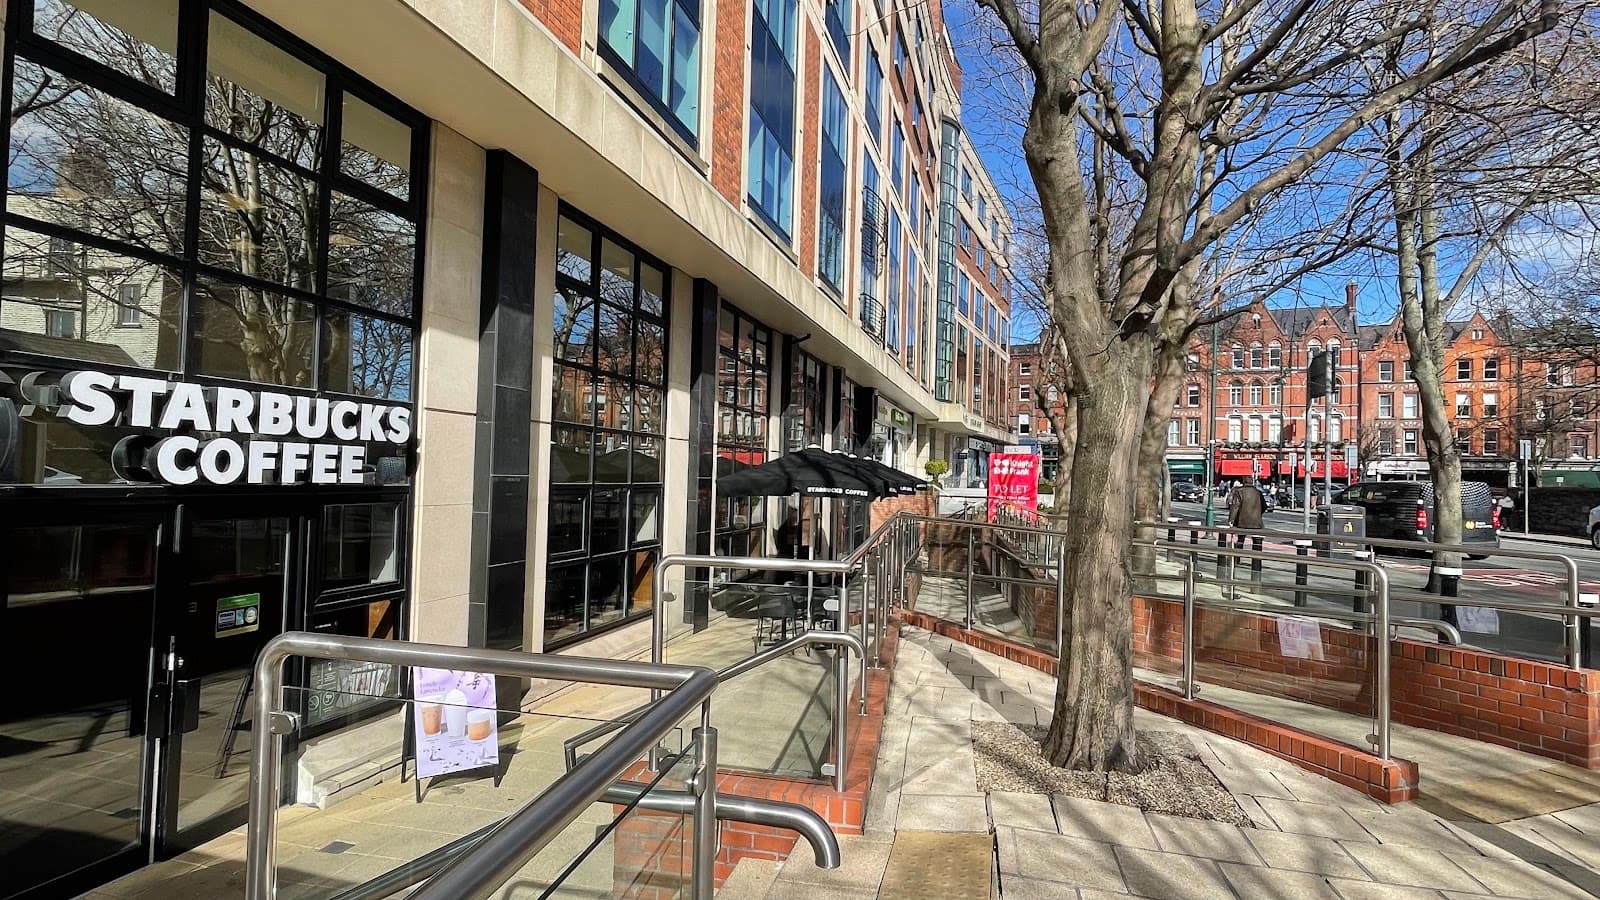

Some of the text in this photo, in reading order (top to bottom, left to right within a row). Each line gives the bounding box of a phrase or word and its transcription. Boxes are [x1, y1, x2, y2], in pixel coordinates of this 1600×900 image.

[67, 370, 411, 444] STARBUCKS
[157, 436, 366, 485] COFFEE
[1010, 459, 1033, 468] Knight
[807, 486, 869, 497] STARBUCKS COFFEE
[993, 484, 1028, 494] TO LET
